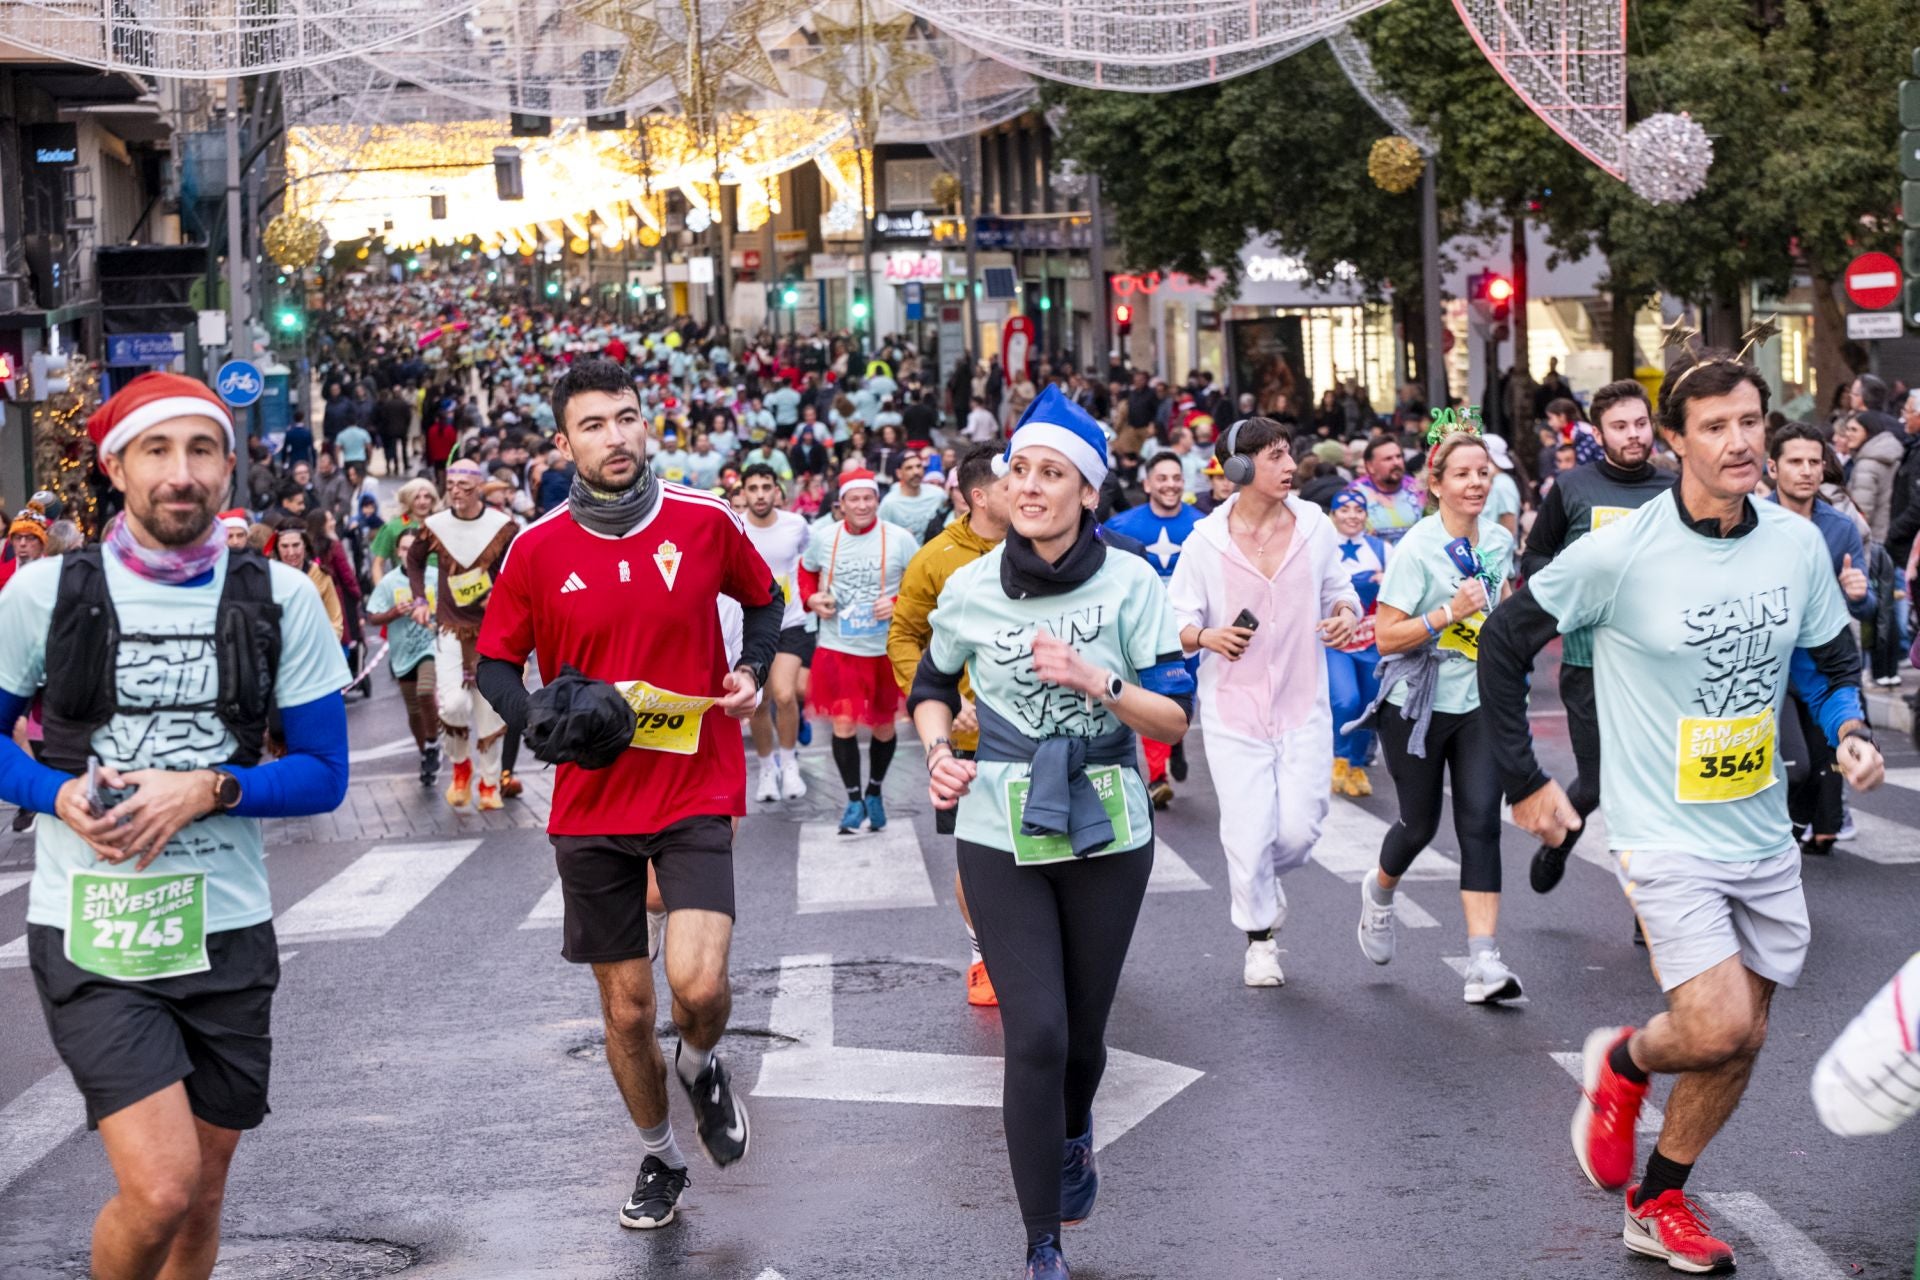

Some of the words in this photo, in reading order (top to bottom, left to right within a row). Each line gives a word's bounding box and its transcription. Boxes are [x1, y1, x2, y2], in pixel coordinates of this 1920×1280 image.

[1682, 586, 1789, 647] SAN
[1691, 724, 1733, 744] SAN
[1698, 746, 1766, 779] 3543
[82, 876, 196, 921] SILVESTRE
[83, 881, 129, 902] SAN
[149, 895, 194, 919] MURCIA
[91, 917, 184, 950] 2745
